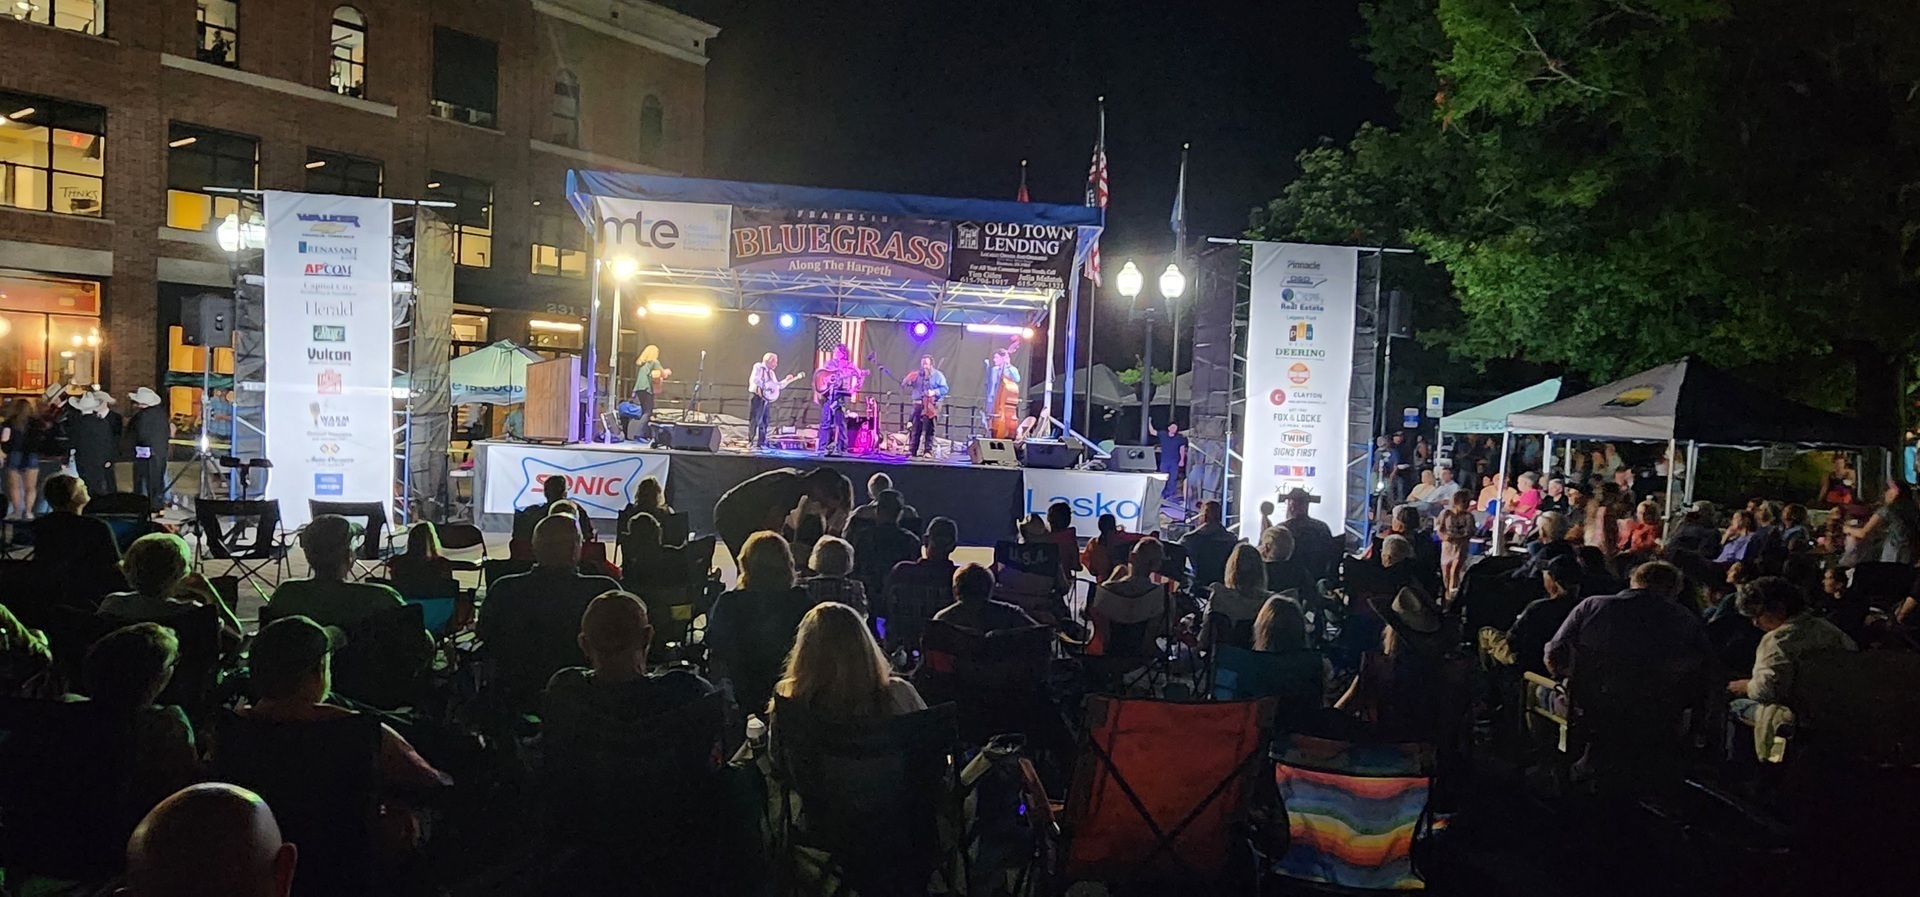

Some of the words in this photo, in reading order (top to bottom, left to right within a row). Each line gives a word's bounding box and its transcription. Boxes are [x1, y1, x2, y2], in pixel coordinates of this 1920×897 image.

[797, 210, 888, 223] FRANKLIN
[599, 210, 680, 249] mte
[984, 222, 1020, 237] OLD
[1022, 224, 1075, 240] TOWN
[308, 245, 358, 255] RENASANT
[732, 224, 948, 270] BLUEGRASS
[984, 237, 1060, 255] LENDING
[788, 259, 821, 272] Along
[823, 260, 844, 270] The
[846, 262, 892, 277] Harpeth
[1287, 260, 1321, 270] Pinnacle
[305, 301, 353, 316] Herald
[546, 302, 577, 316] 231
[1293, 391, 1323, 399] CLAYTON
[1273, 413, 1289, 421] FOX
[1296, 414, 1322, 422] LOCKE
[1282, 434, 1310, 442] TWINE
[1273, 447, 1296, 457] SIGNS
[1296, 449, 1317, 458] FIRST
